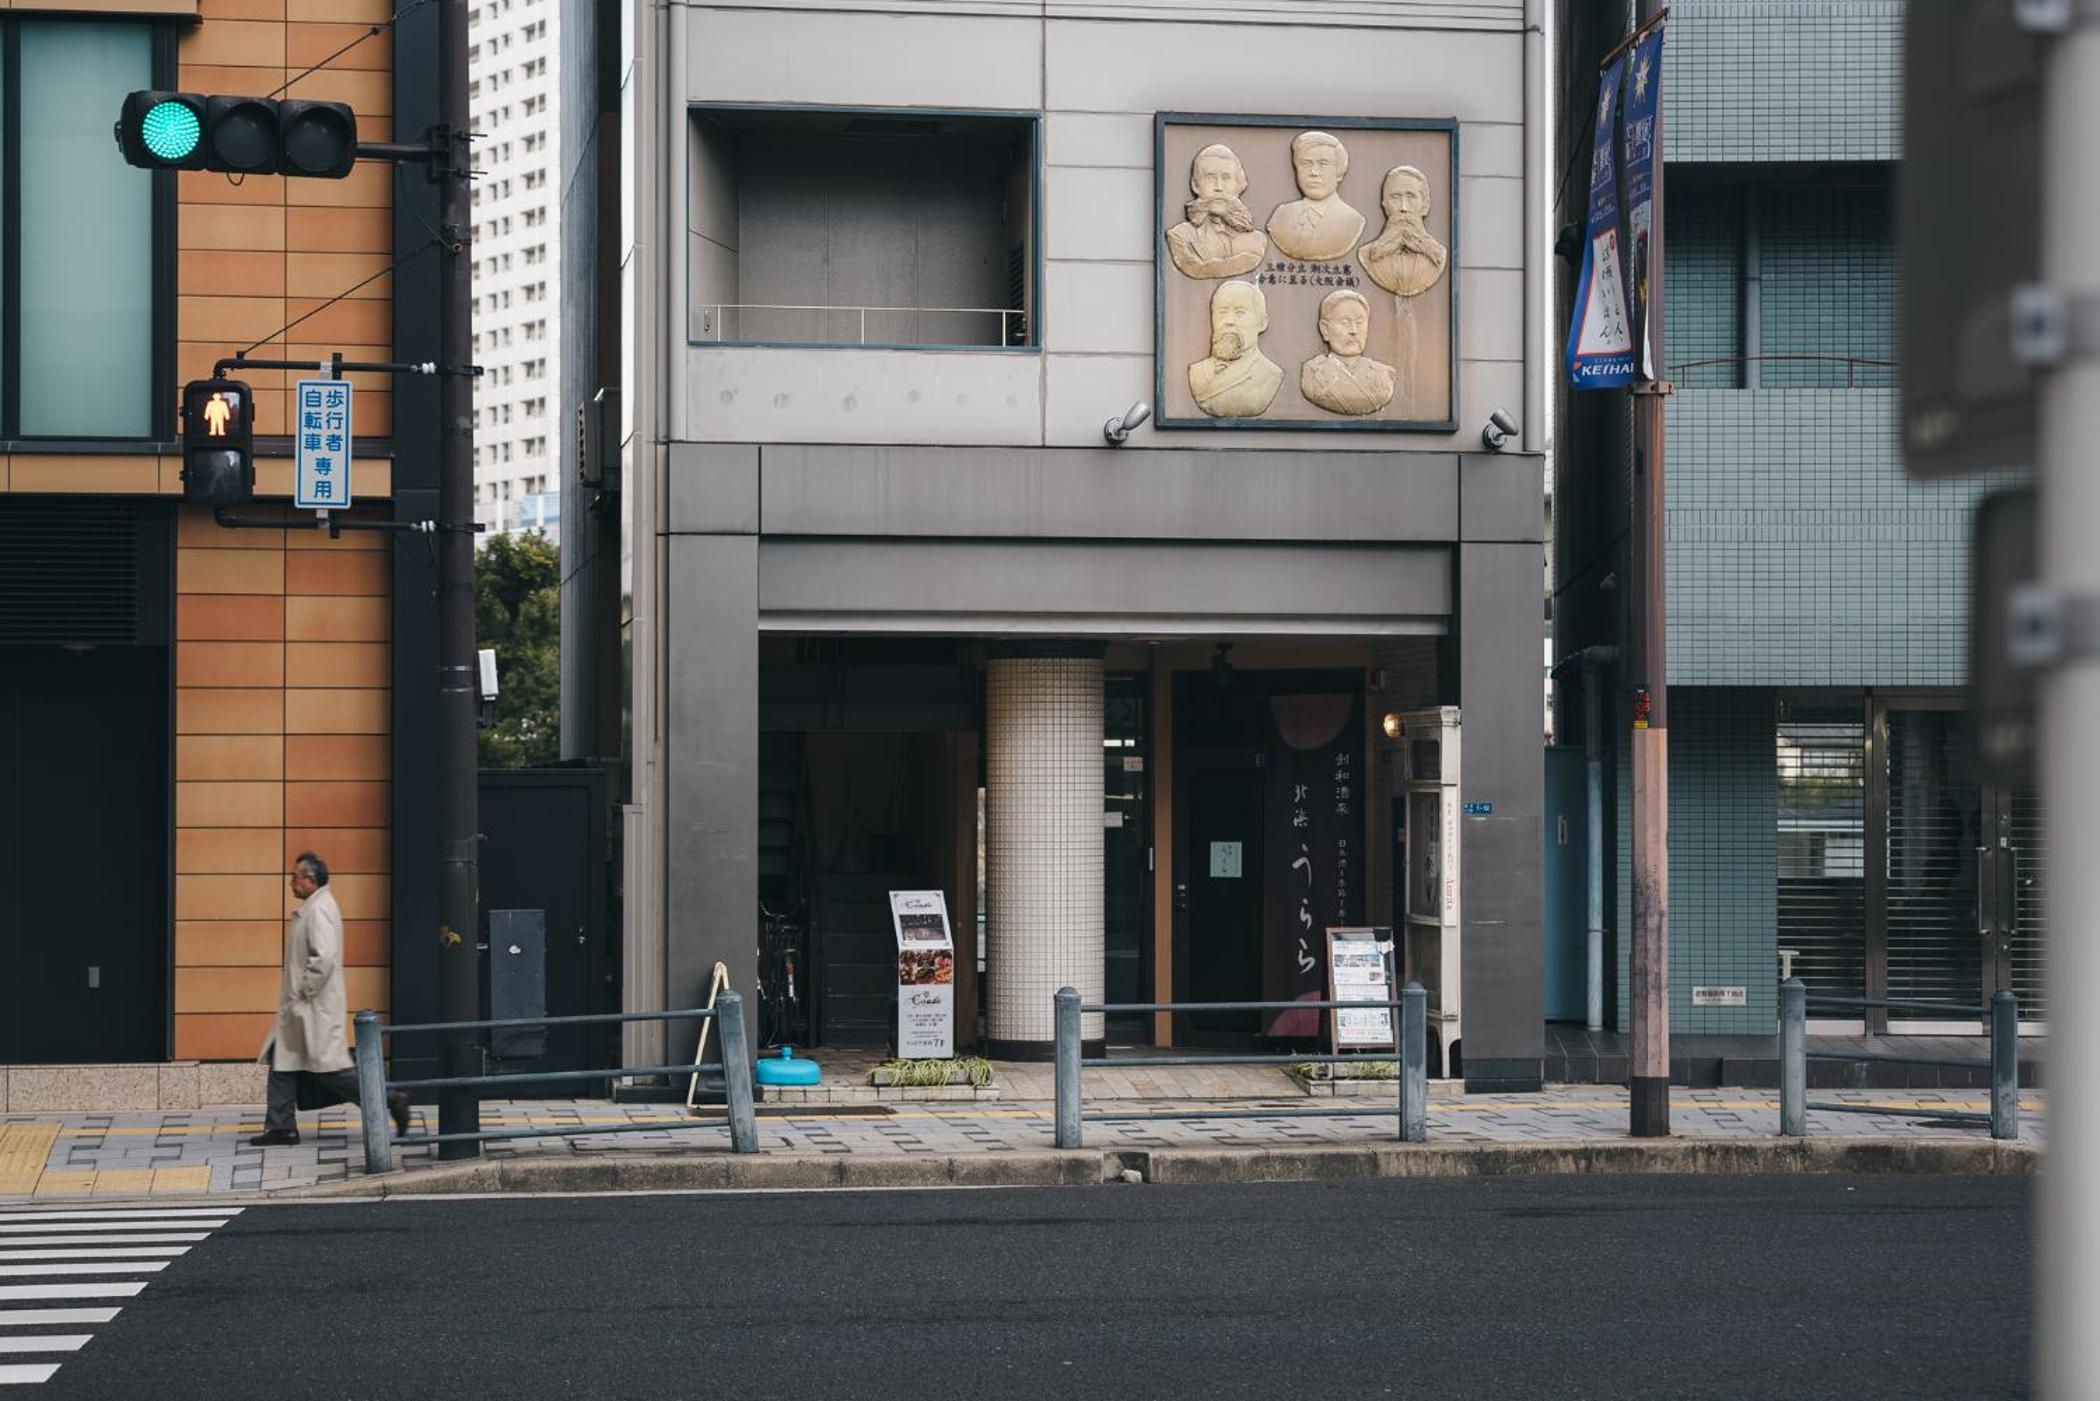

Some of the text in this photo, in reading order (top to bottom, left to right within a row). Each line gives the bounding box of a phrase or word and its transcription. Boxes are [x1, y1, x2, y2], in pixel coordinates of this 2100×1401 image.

[304, 390, 322, 452] 自転車
[326, 390, 344, 452] 歩行者
[314, 457, 332, 499] 専用
